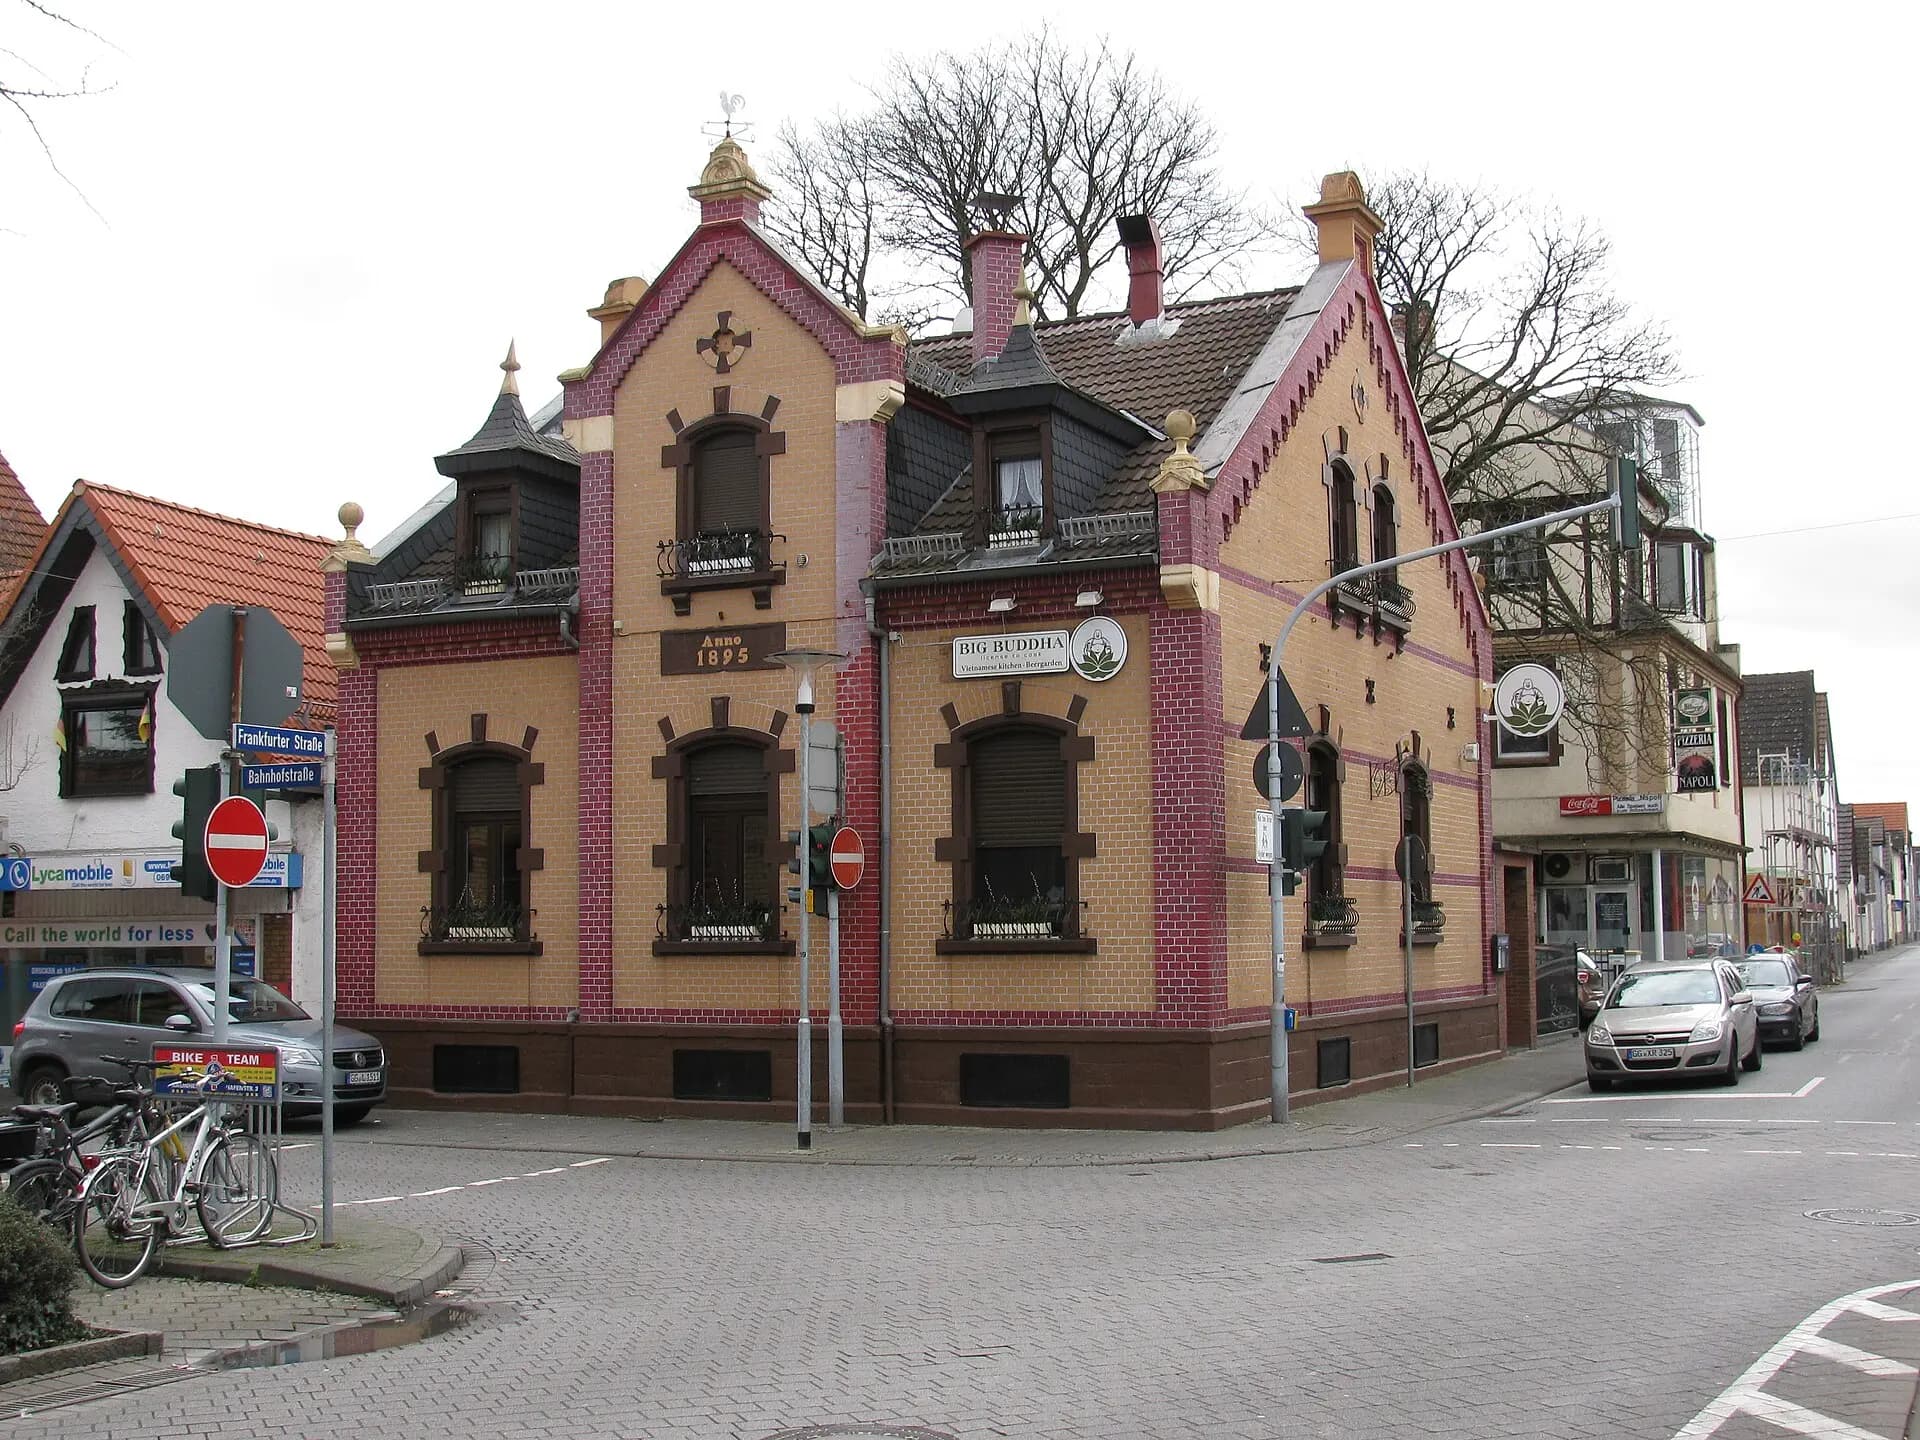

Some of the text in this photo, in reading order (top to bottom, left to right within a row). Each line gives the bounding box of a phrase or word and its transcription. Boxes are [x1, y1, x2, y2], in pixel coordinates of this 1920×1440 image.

[701, 634, 742, 648] Anno
[959, 637, 1064, 655] BIG BUDDHA
[696, 647, 749, 667] 1895
[961, 664, 998, 672] Vietnamese
[238, 728, 323, 752] Frankfurter Straße
[1677, 733, 1712, 747] PIZZERIA
[248, 766, 314, 785] Bahnhofstraße
[1680, 775, 1715, 788] NAPOLI
[32, 864, 113, 884] Lycamobile
[4, 925, 194, 943] Call the world for less
[172, 1051, 259, 1065] BIKE TEAM
